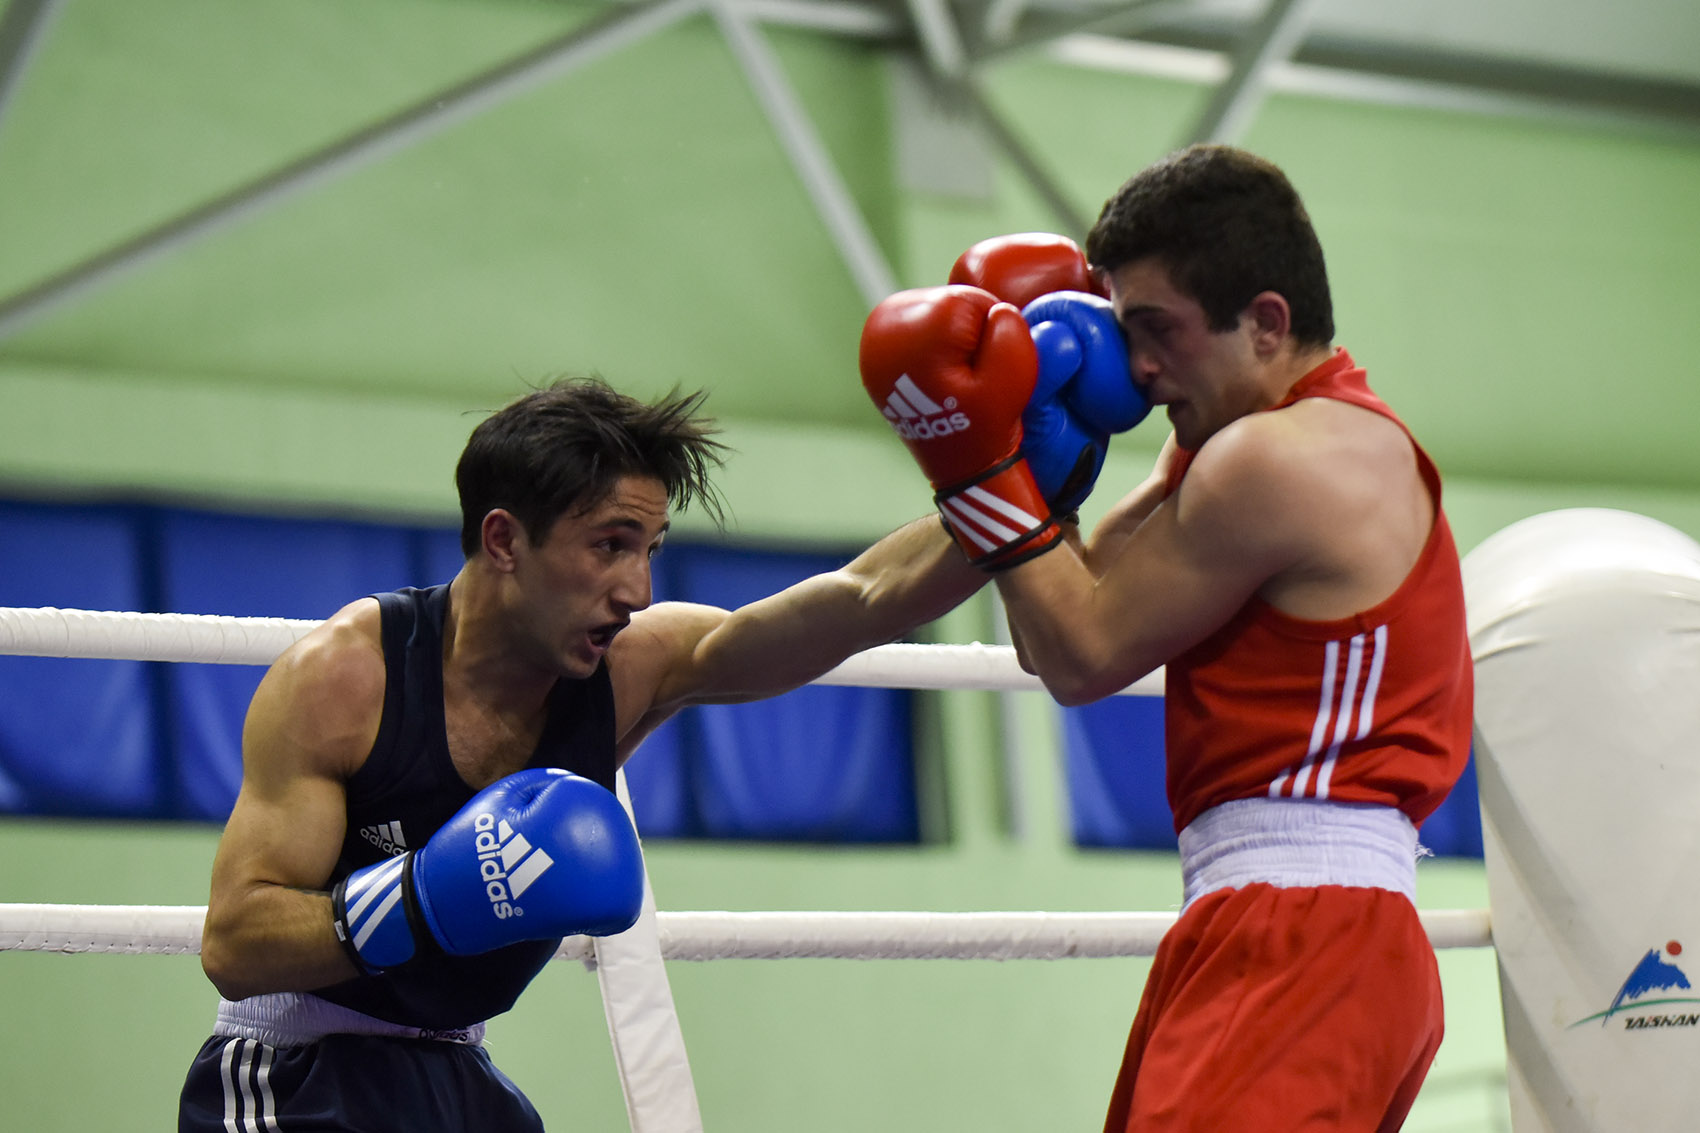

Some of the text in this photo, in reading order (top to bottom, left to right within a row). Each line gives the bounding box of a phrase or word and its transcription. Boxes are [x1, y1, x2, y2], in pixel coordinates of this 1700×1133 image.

[890, 412, 971, 440] didas
[360, 828, 405, 856] adida
[475, 813, 513, 919] adidas
